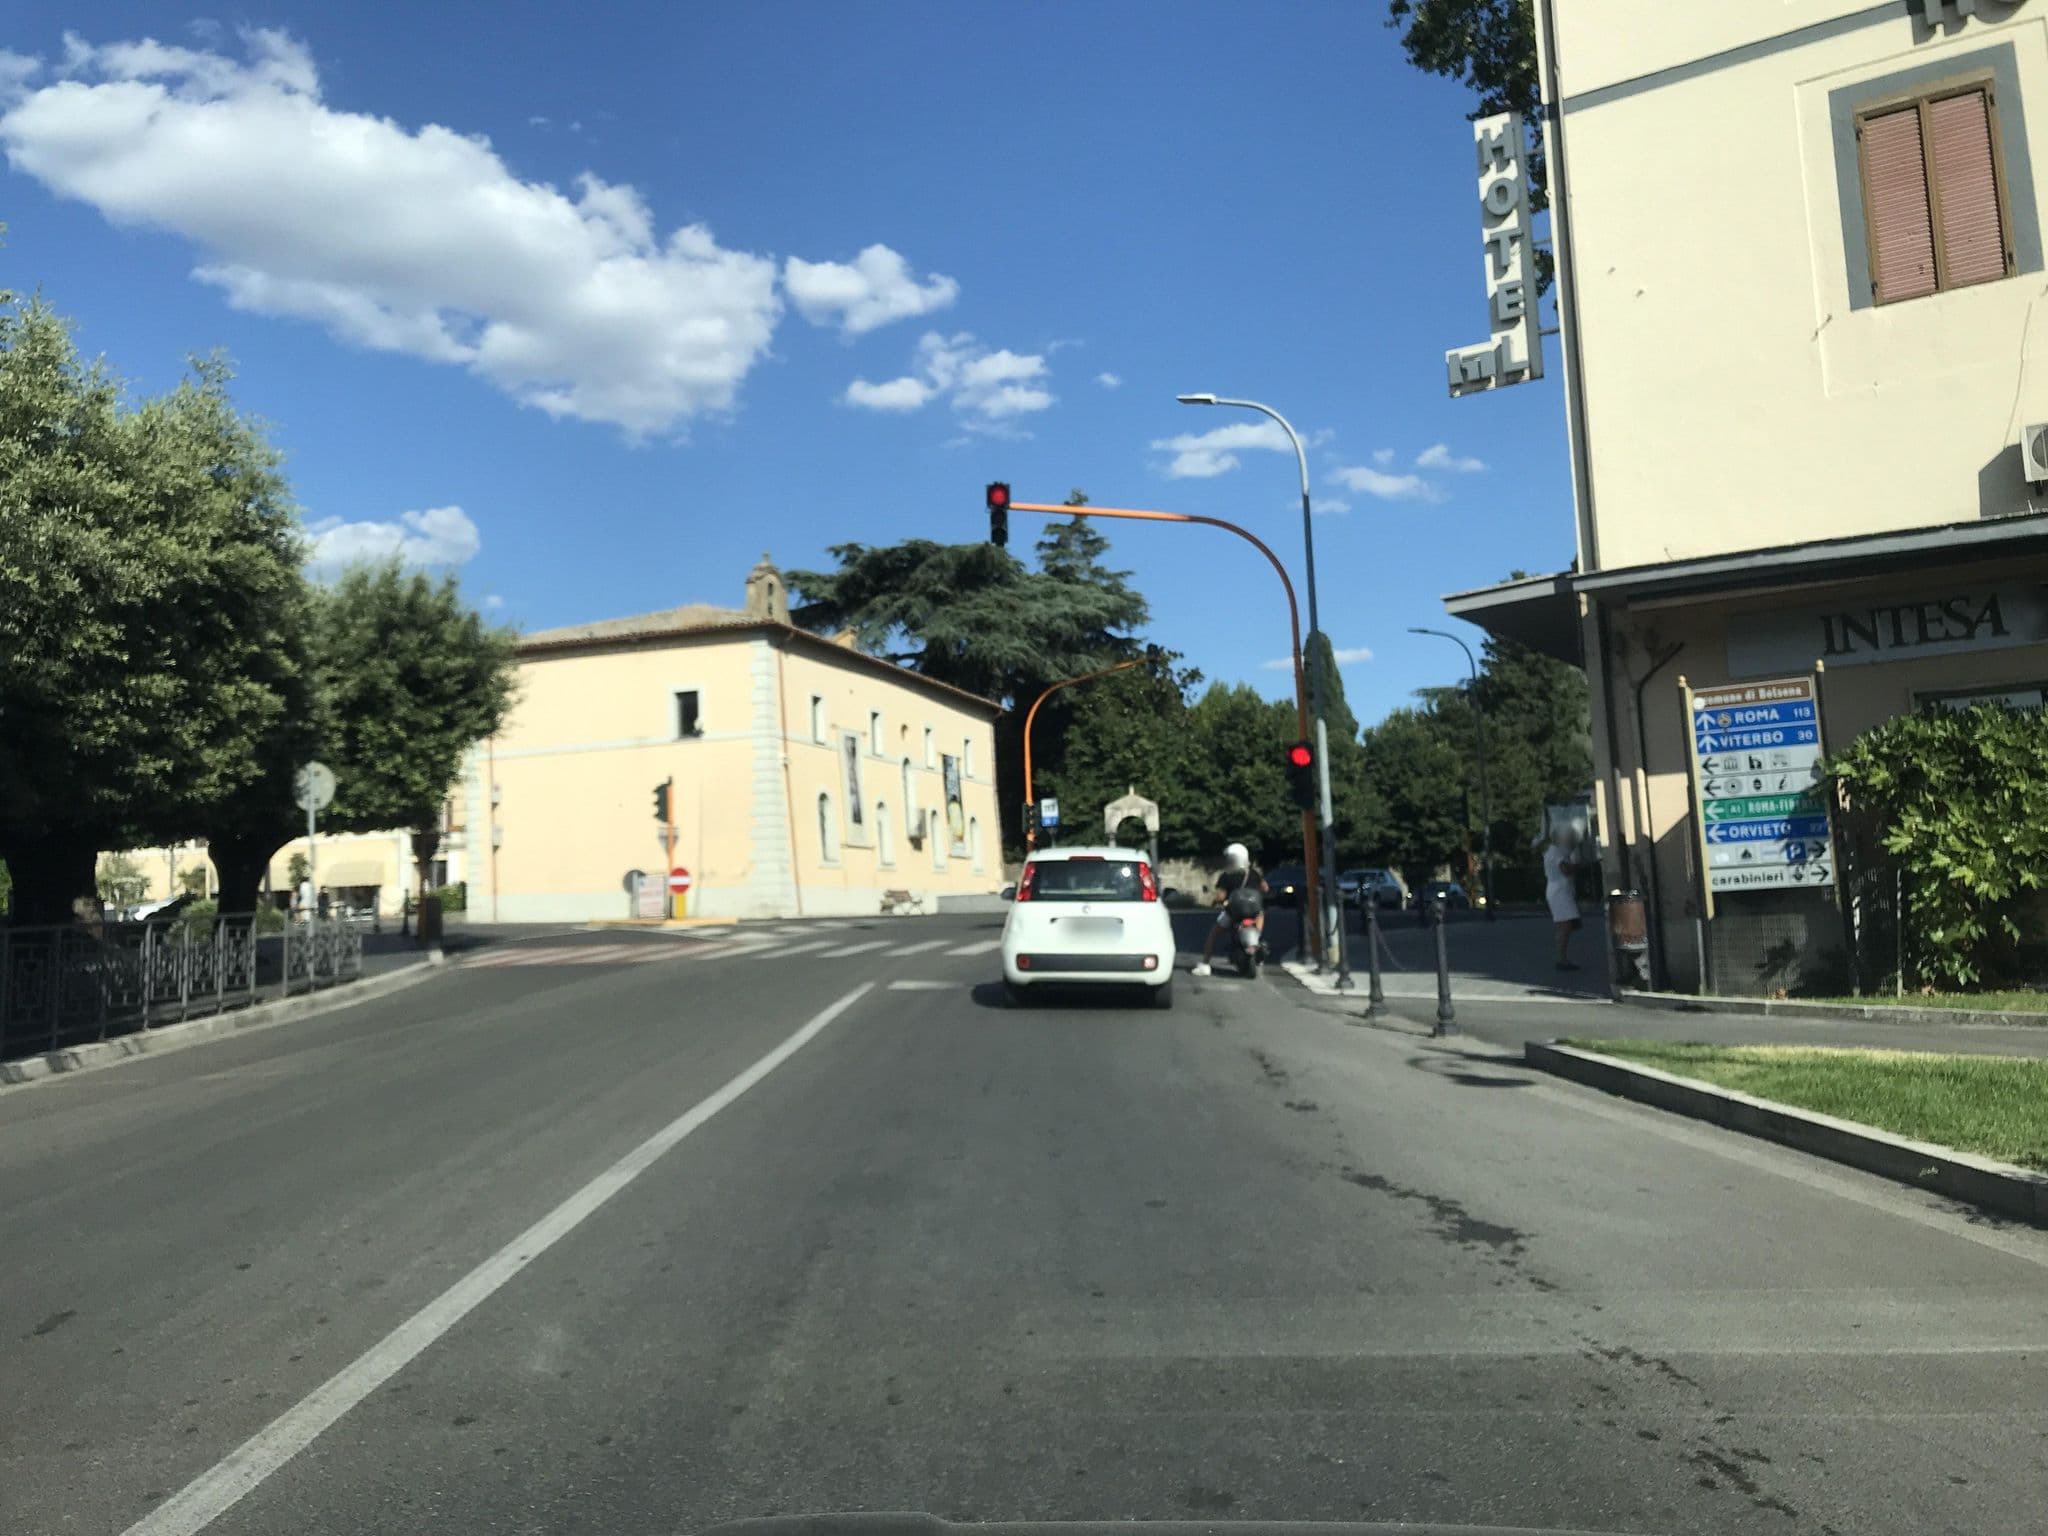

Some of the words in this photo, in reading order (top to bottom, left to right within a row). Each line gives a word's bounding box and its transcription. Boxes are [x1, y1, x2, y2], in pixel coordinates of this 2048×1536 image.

[1481, 121, 1529, 374] HOTEL
[1819, 592, 2011, 656] INTESA
[1744, 688, 1756, 701] di
[1734, 708, 1780, 725] ROMA
[1719, 730, 1784, 748] VITERBO
[1728, 822, 1792, 839] ORVIETO
[1712, 872, 1784, 886] carabinieri
